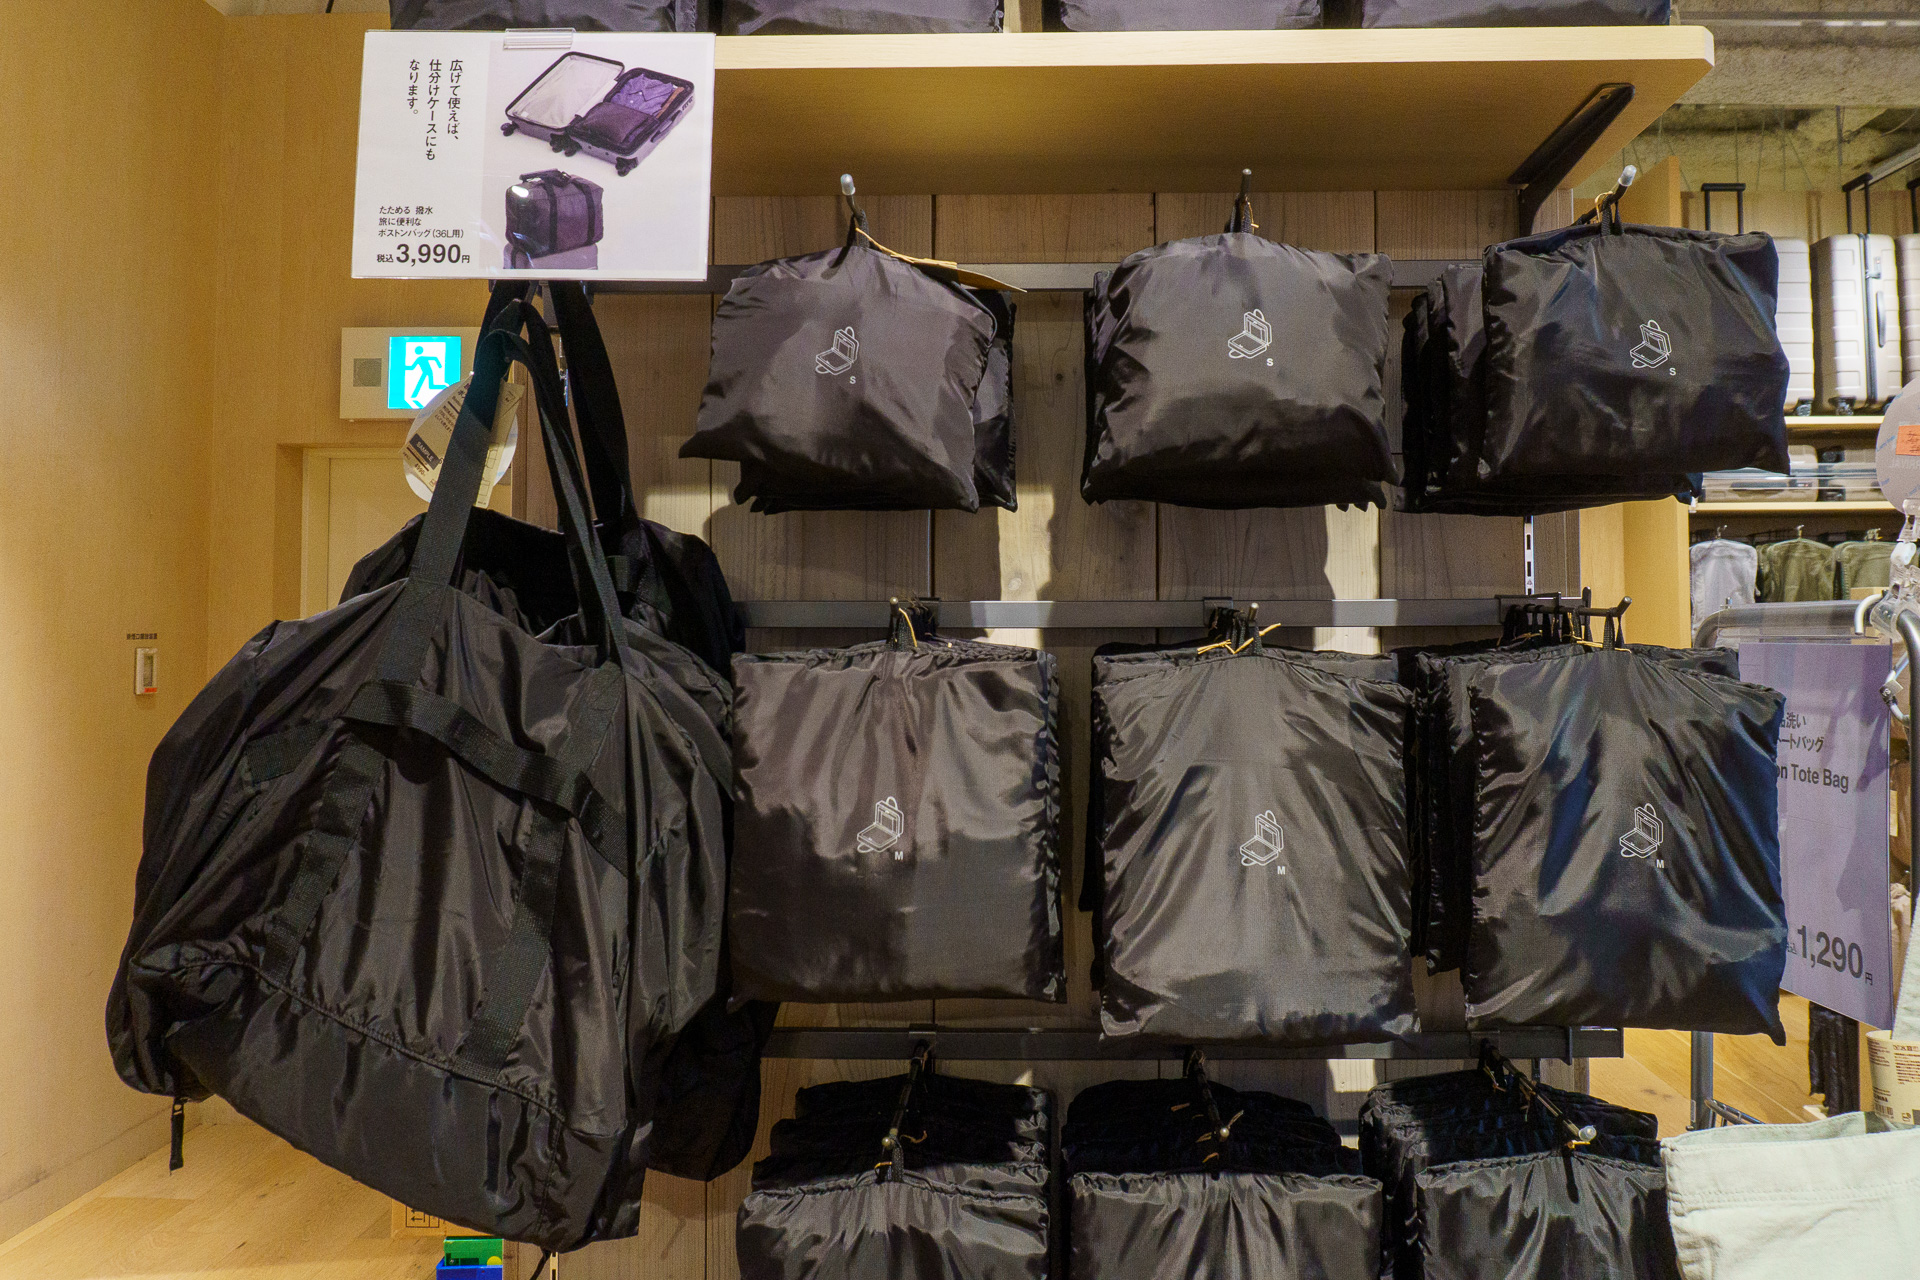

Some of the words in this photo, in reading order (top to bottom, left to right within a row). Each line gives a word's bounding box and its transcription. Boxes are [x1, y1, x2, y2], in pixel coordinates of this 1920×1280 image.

[407, 59, 420, 114] なります。
[447, 59, 463, 140] 広げて使えば、
[426, 59, 442, 160] 仕分けケースにも
[379, 206, 411, 215] たためる
[378, 217, 422, 227] 旅に便利な
[1266, 358, 1274, 367] S
[1669, 367, 1677, 376] S
[849, 375, 857, 385] S
[1791, 763, 1819, 784] Tote
[1823, 768, 1849, 794] Bag
[895, 851, 904, 860] M
[1656, 859, 1665, 868] M
[1277, 865, 1286, 875] M
